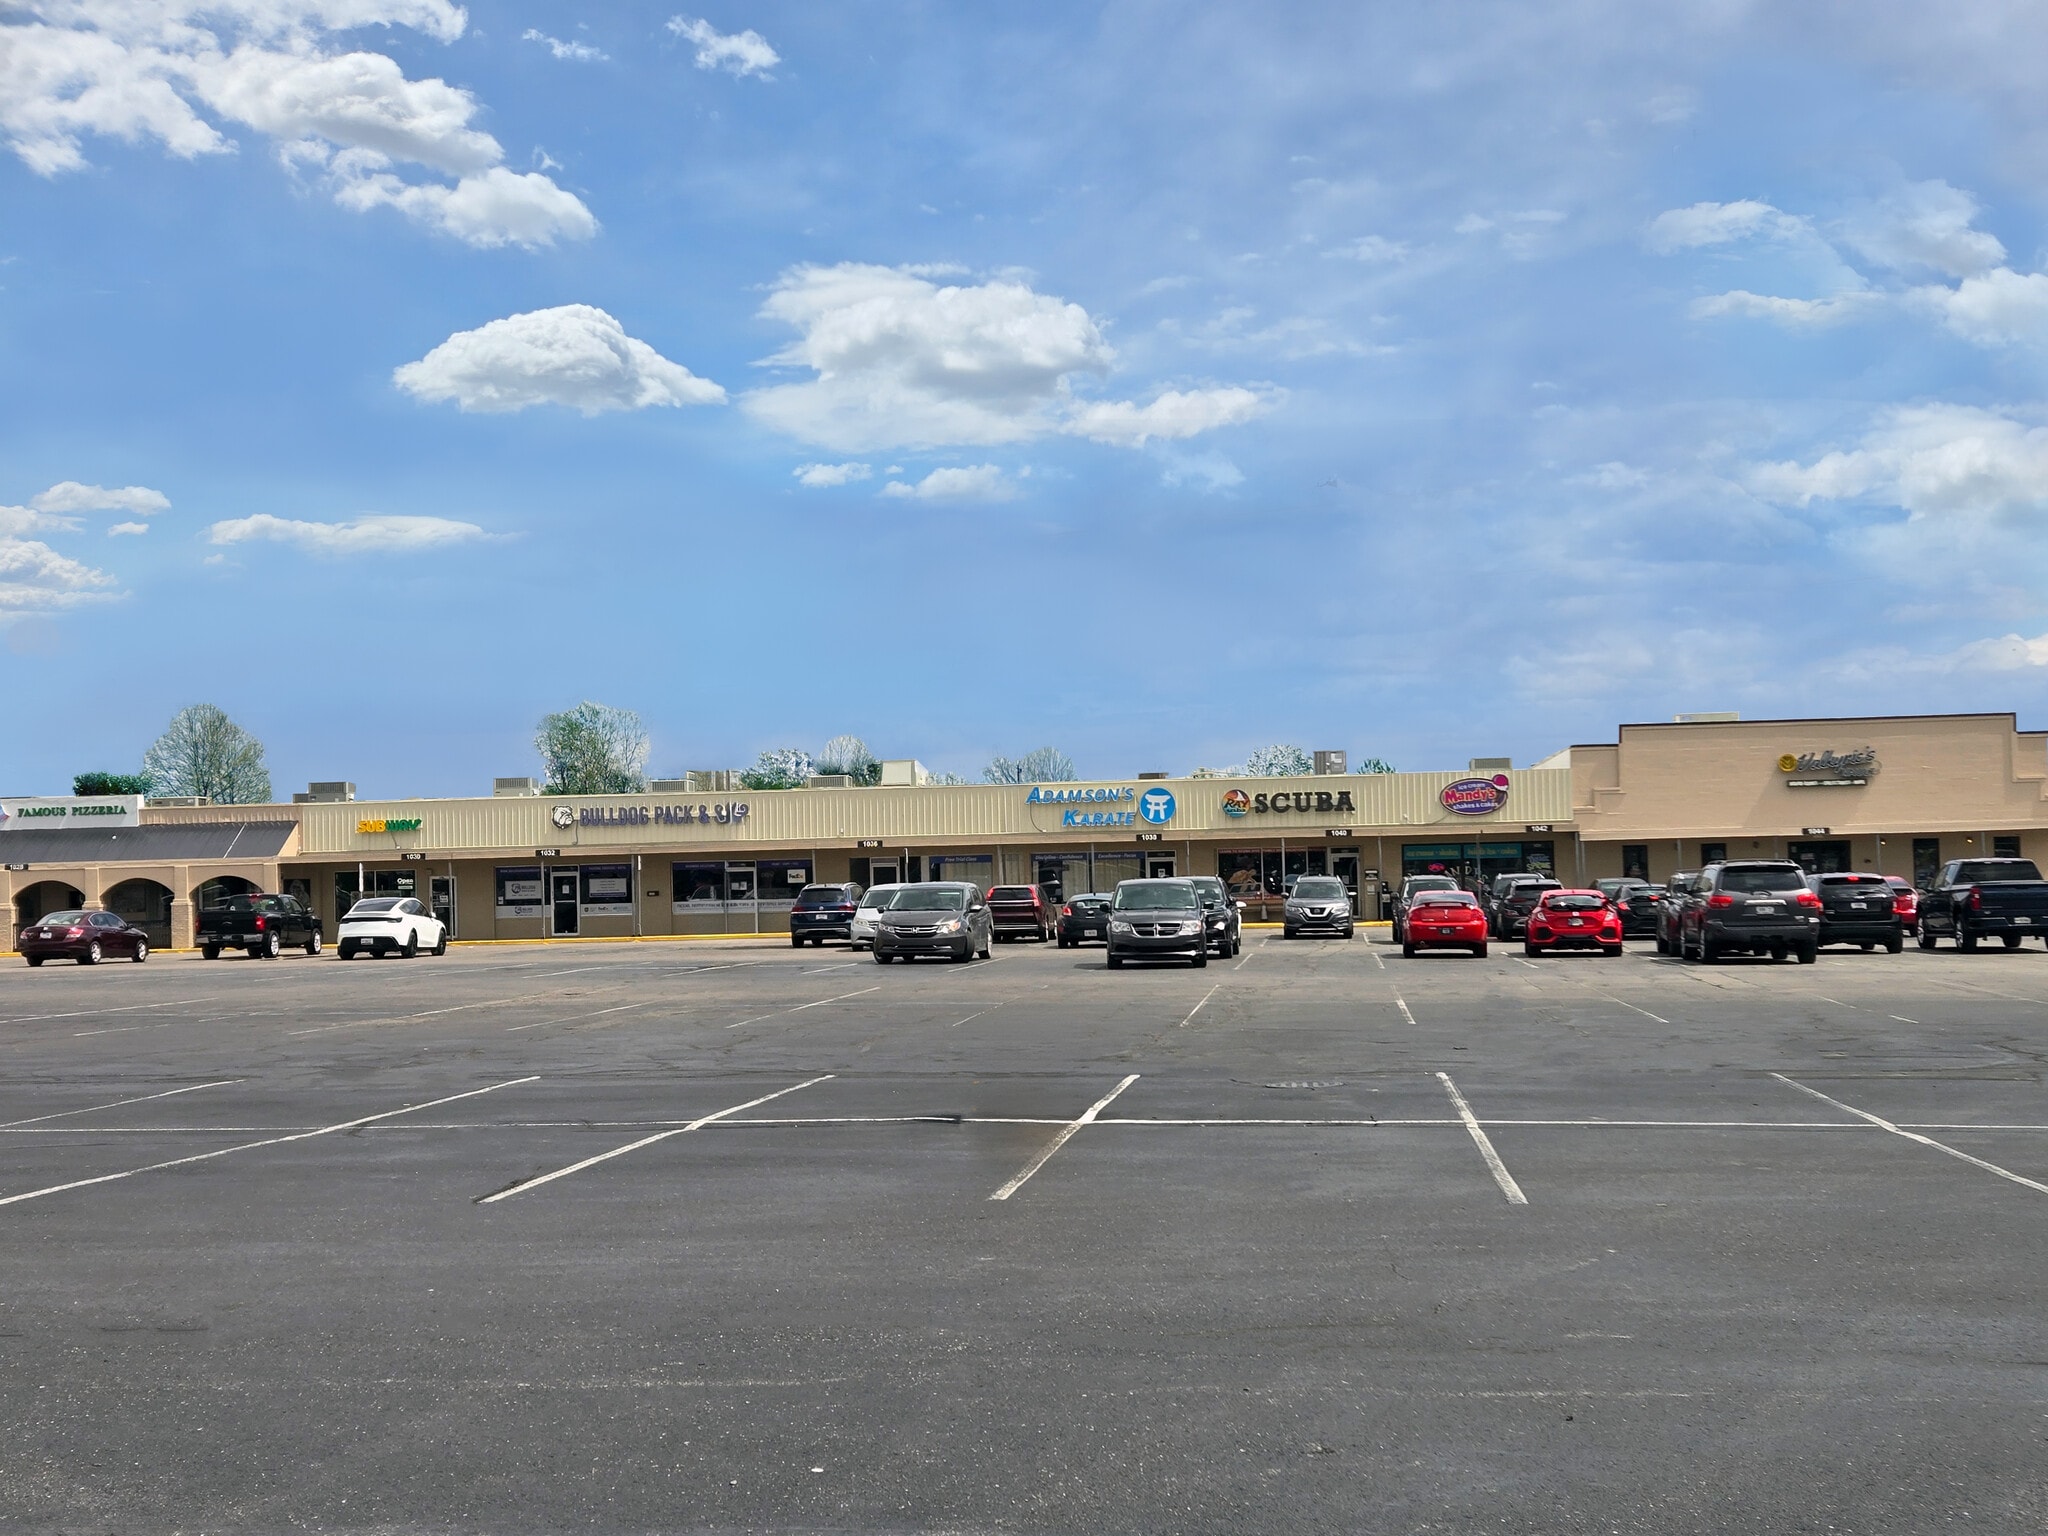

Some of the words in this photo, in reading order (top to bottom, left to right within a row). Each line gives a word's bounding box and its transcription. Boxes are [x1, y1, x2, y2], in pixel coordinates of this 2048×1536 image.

[1026, 786, 1134, 804] ADAMSON'S
[1223, 798, 1248, 808] RAY
[1255, 791, 1355, 813] SCUBA
[1444, 787, 1496, 804] Mandy's
[18, 807, 66, 817] FAMOUS
[71, 805, 127, 816] PIZZERIA
[579, 806, 649, 826] BULLDOG
[654, 805, 694, 824] PACK
[698, 804, 710, 824] &
[1062, 808, 1135, 827] KARATE
[356, 818, 421, 833] SUBWAY
